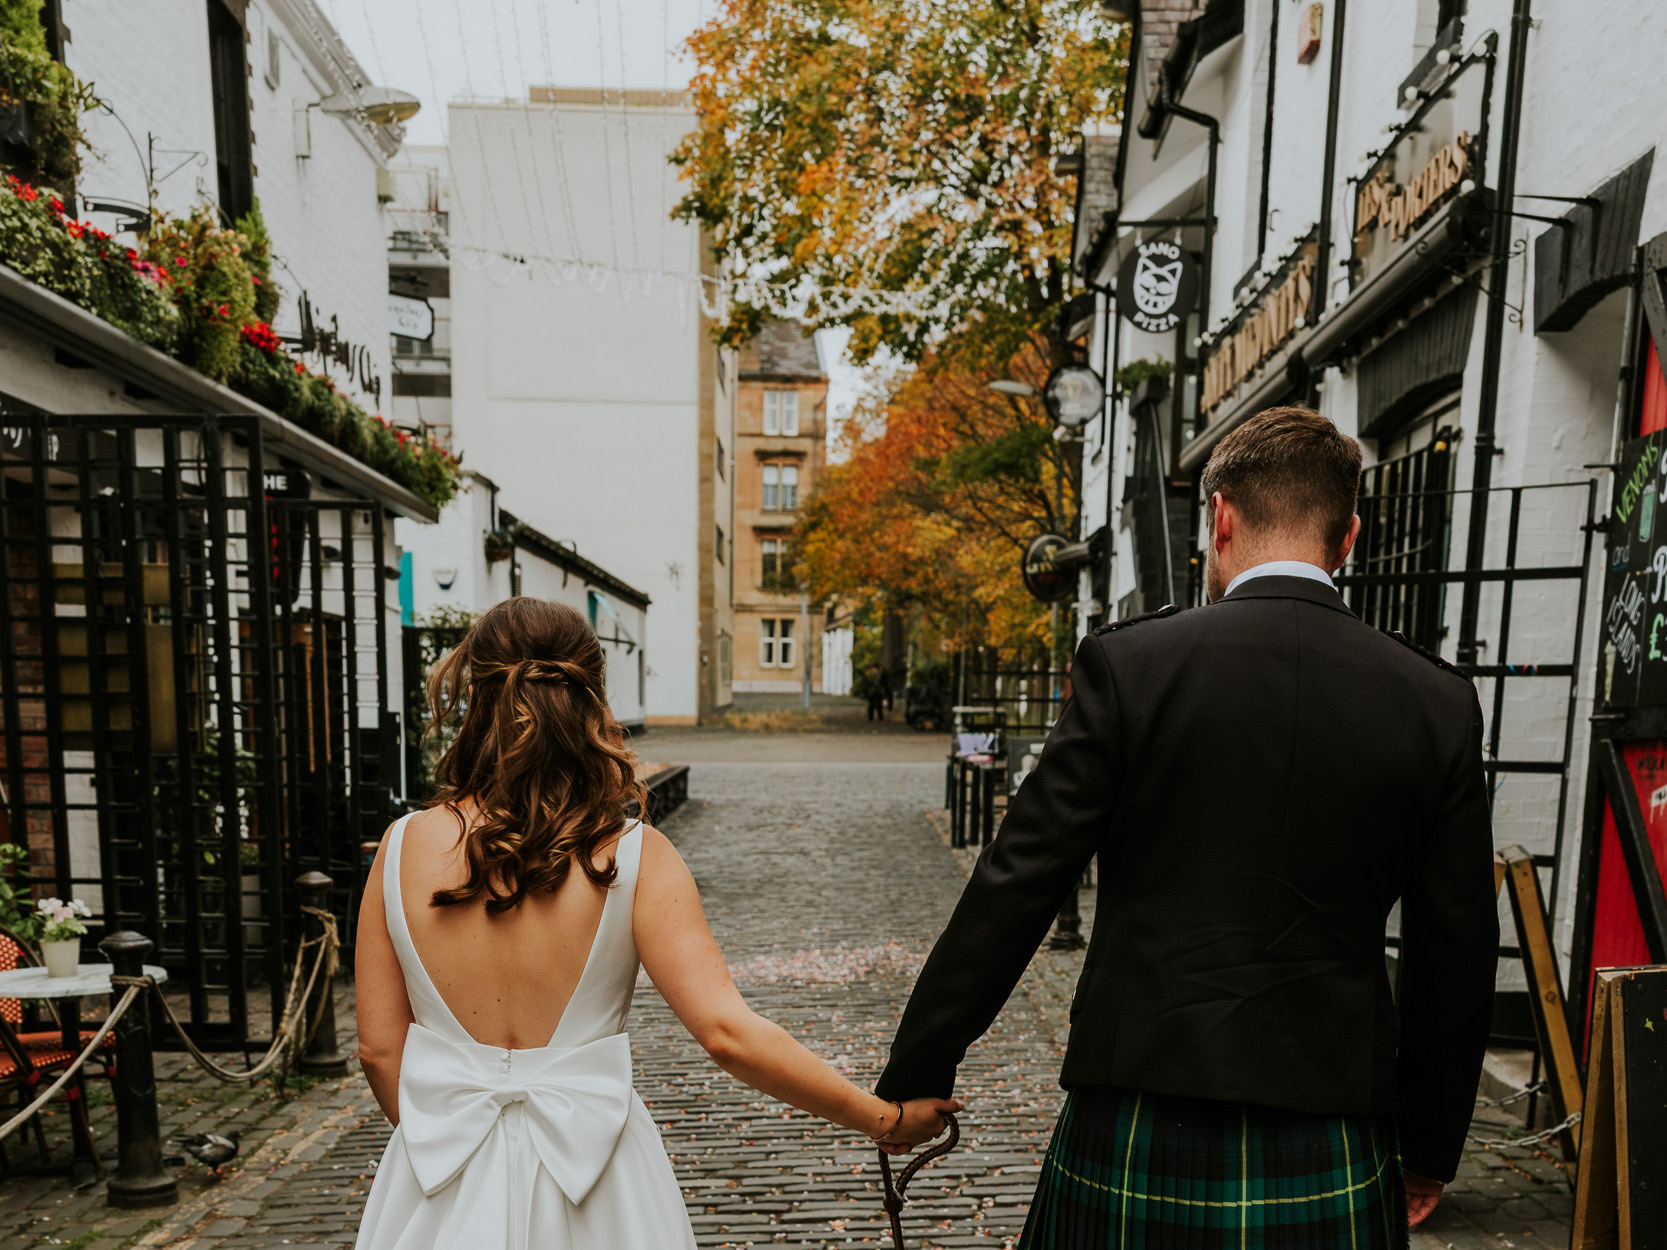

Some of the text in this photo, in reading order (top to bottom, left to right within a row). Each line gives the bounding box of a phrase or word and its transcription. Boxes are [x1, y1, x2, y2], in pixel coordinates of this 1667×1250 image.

[1138, 241, 1180, 260] SANO
[1133, 311, 1180, 332] PIZZA
[1616, 432, 1659, 523] VENOMS
